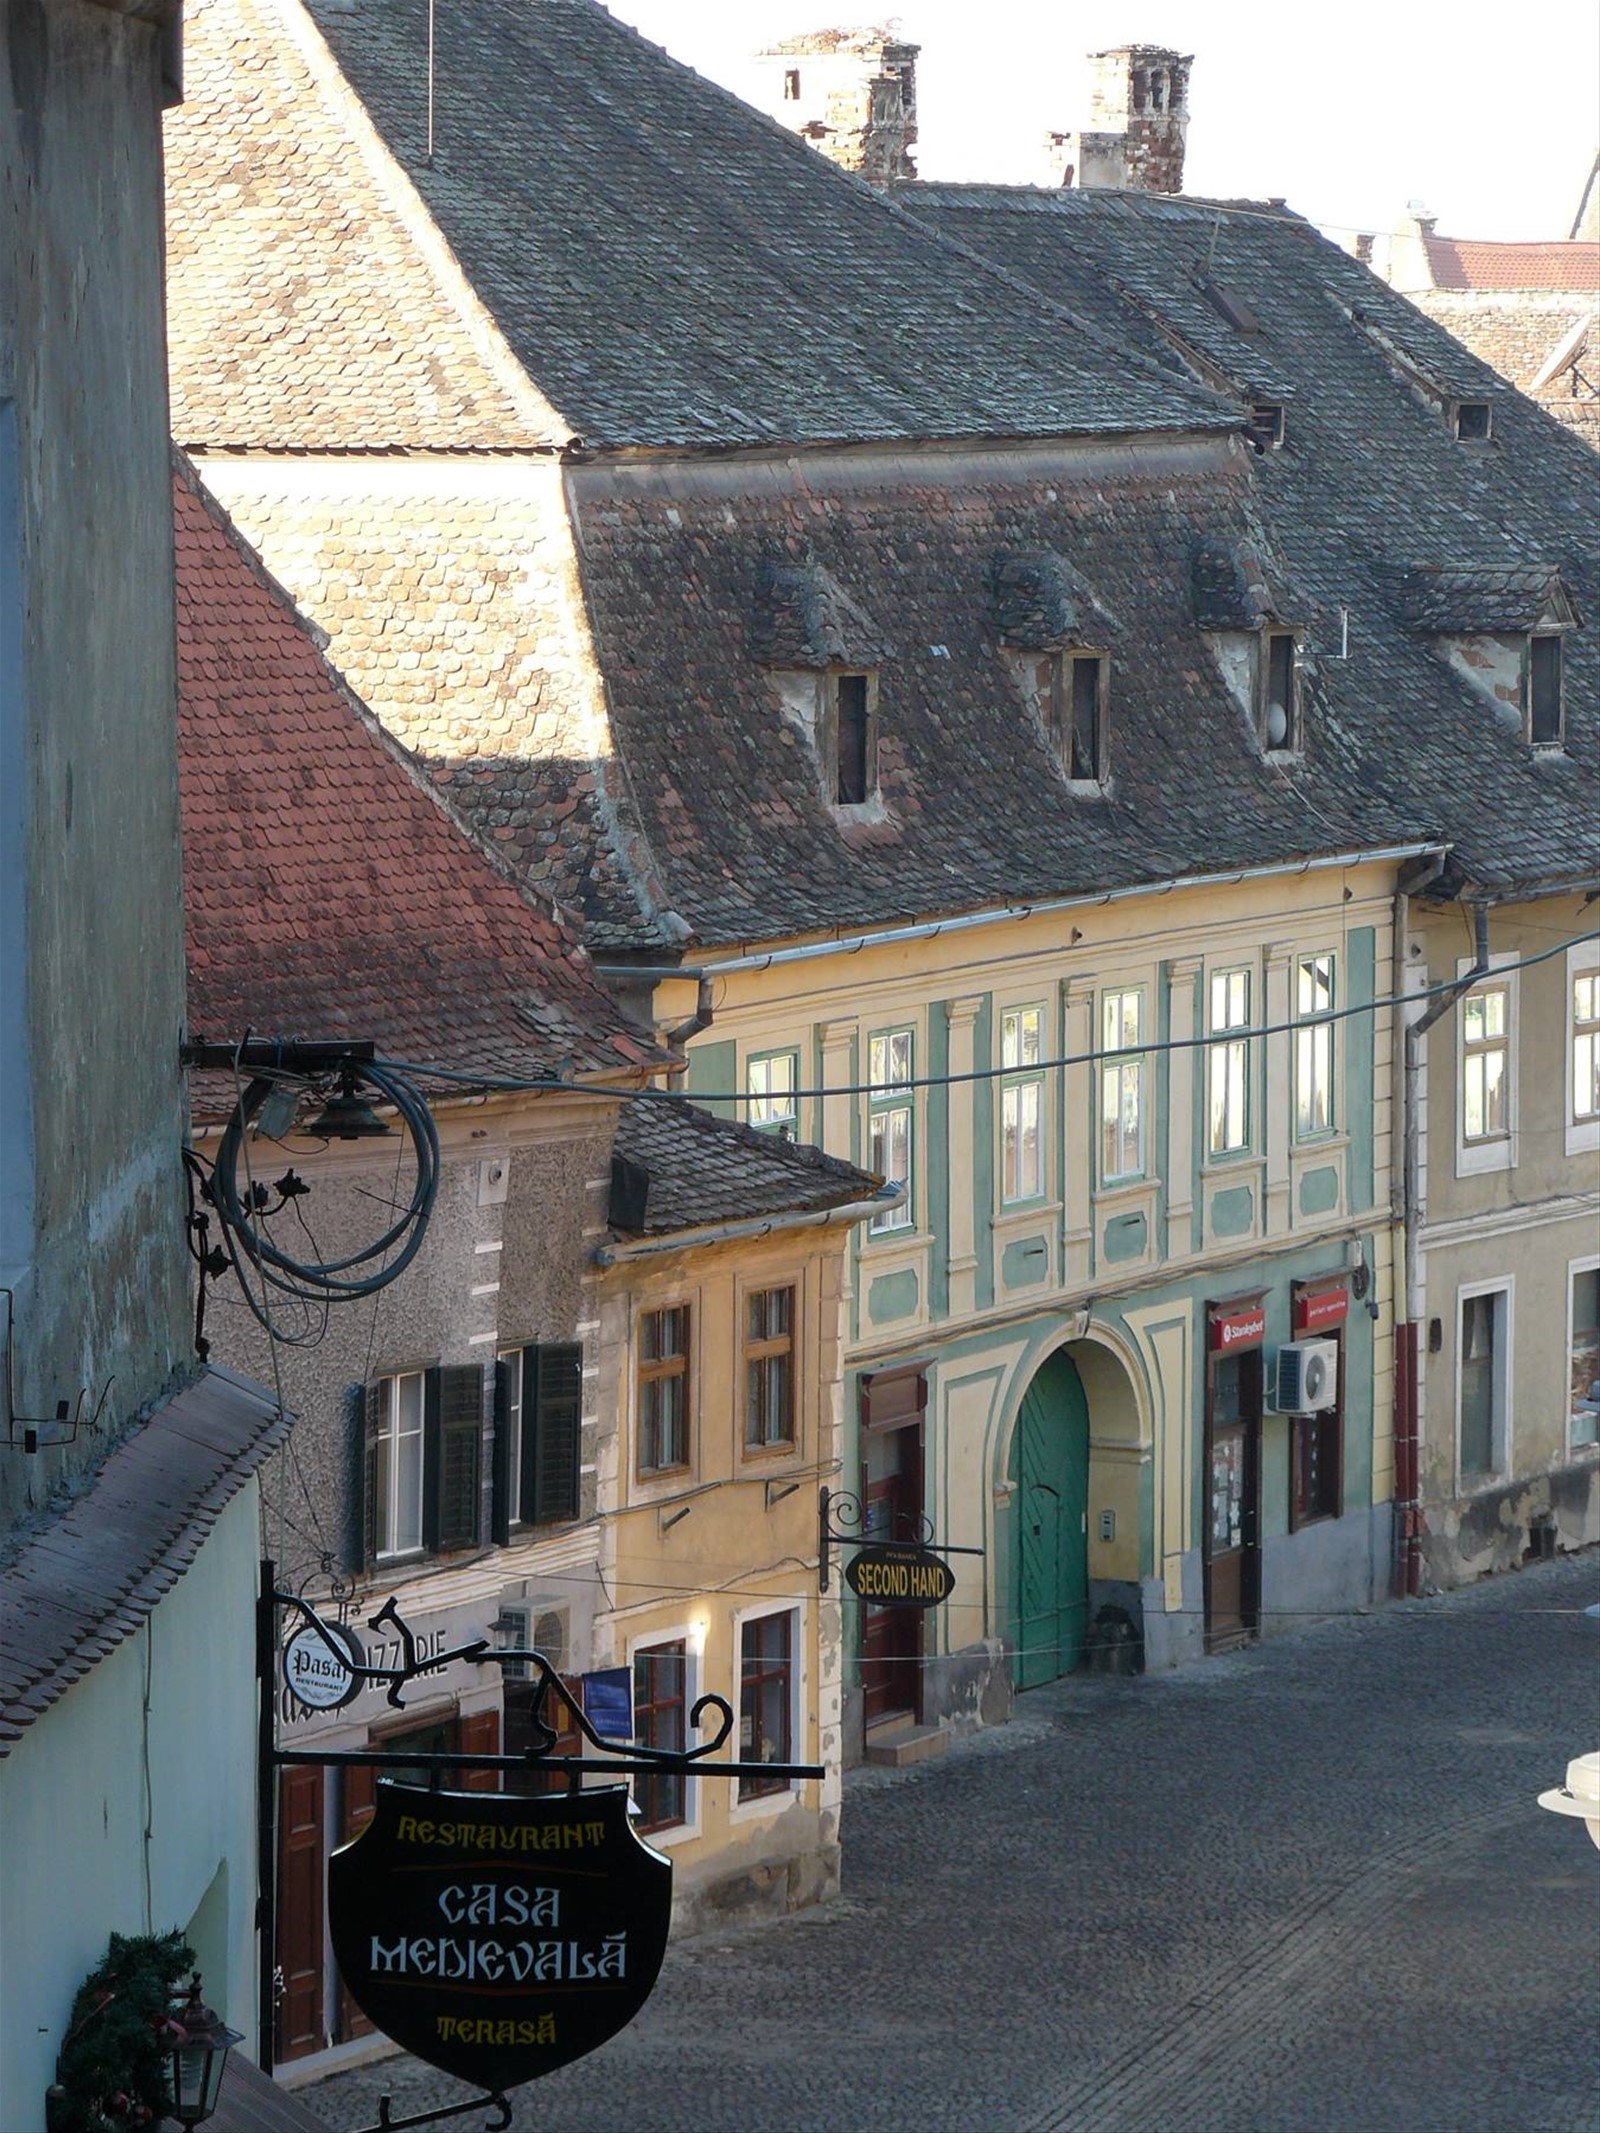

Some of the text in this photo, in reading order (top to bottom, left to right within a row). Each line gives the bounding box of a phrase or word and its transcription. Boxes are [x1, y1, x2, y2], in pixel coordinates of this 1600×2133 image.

[858, 1563, 945, 1598] SECOND HAND
[366, 1630, 448, 1690] IZZRIE
[295, 1677, 344, 1692] RESTAURANT
[396, 1815, 606, 1850] RESTAURANT
[438, 1884, 560, 1927] CASA
